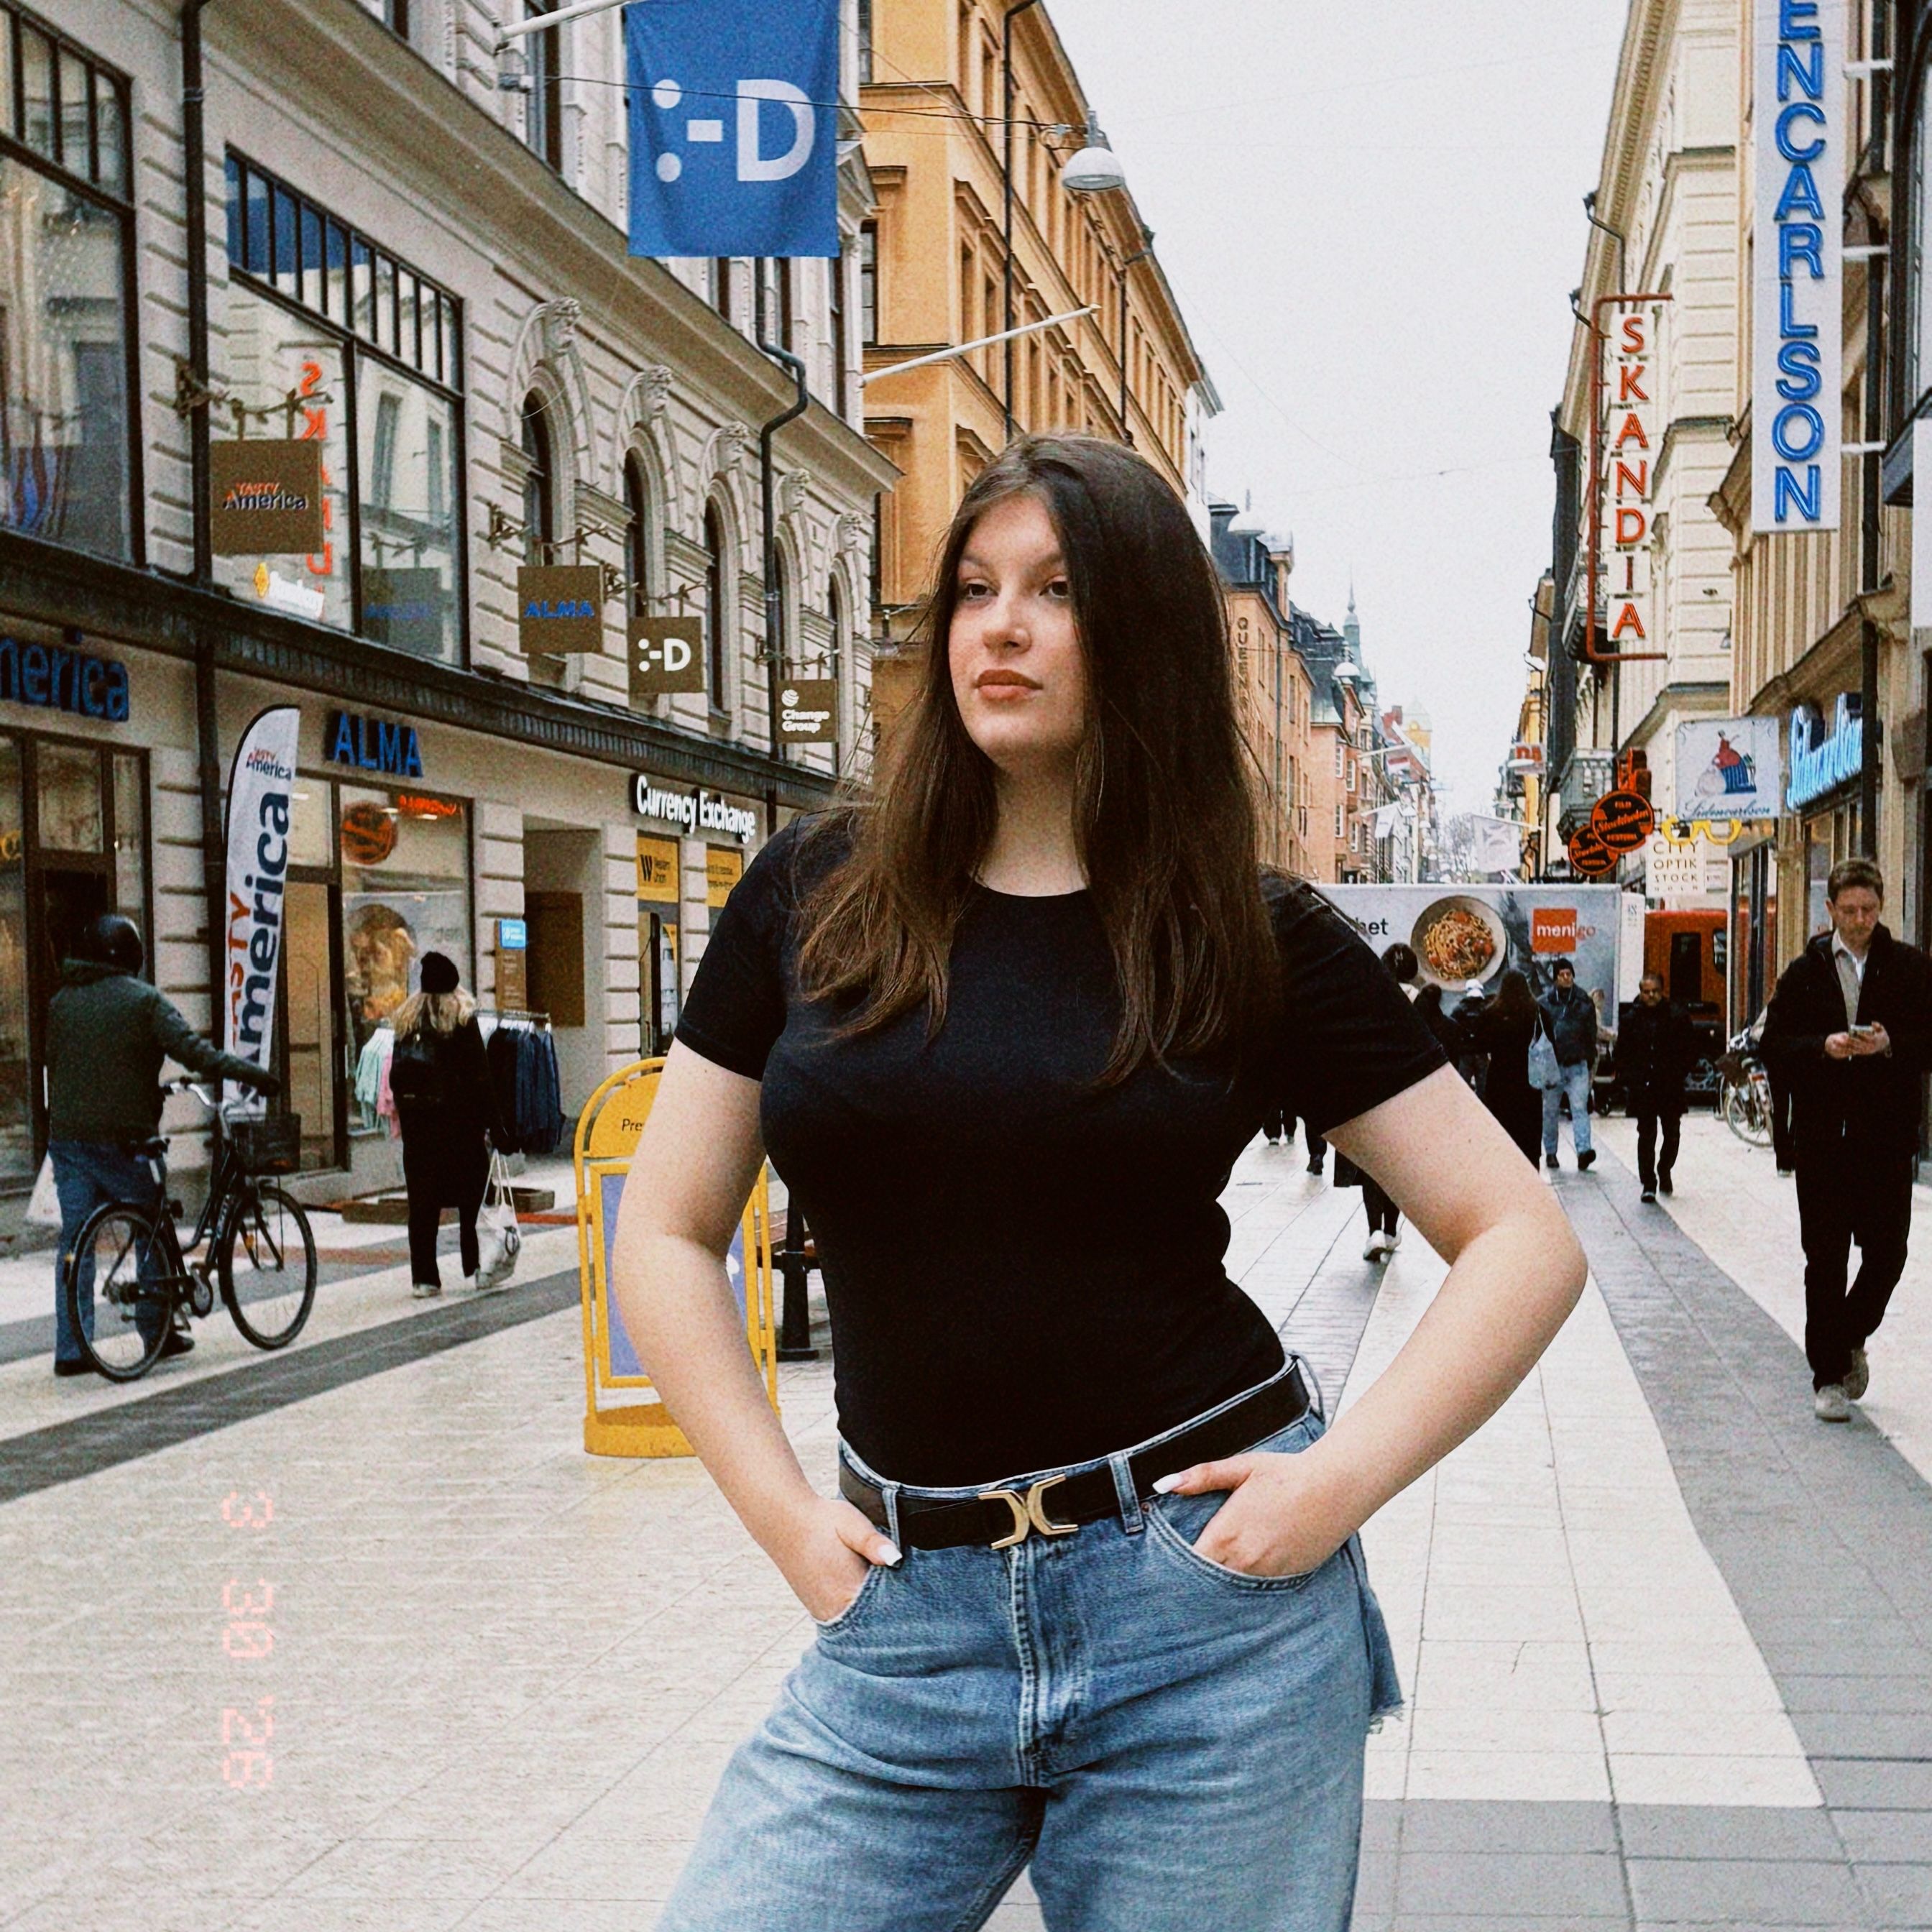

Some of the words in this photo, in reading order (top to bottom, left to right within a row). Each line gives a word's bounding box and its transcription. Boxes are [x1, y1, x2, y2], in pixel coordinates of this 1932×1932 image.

[1772, 0, 1827, 523] ENCARLSON
[1612, 316, 1649, 638] SKANDIA
[223, 489, 308, 511] America
[523, 600, 595, 618] ALMA
[781, 709, 830, 722] Change
[781, 720, 821, 734] Group
[333, 711, 423, 778] ALMA
[637, 775, 697, 834] Currency
[699, 791, 756, 845] Exchange
[1653, 840, 1699, 855] CITY
[1653, 859, 1697, 870] OPTIK
[1655, 873, 1698, 883] STOCK
[1536, 921, 1596, 941] menigo
[622, 1118, 645, 1132] Pre
